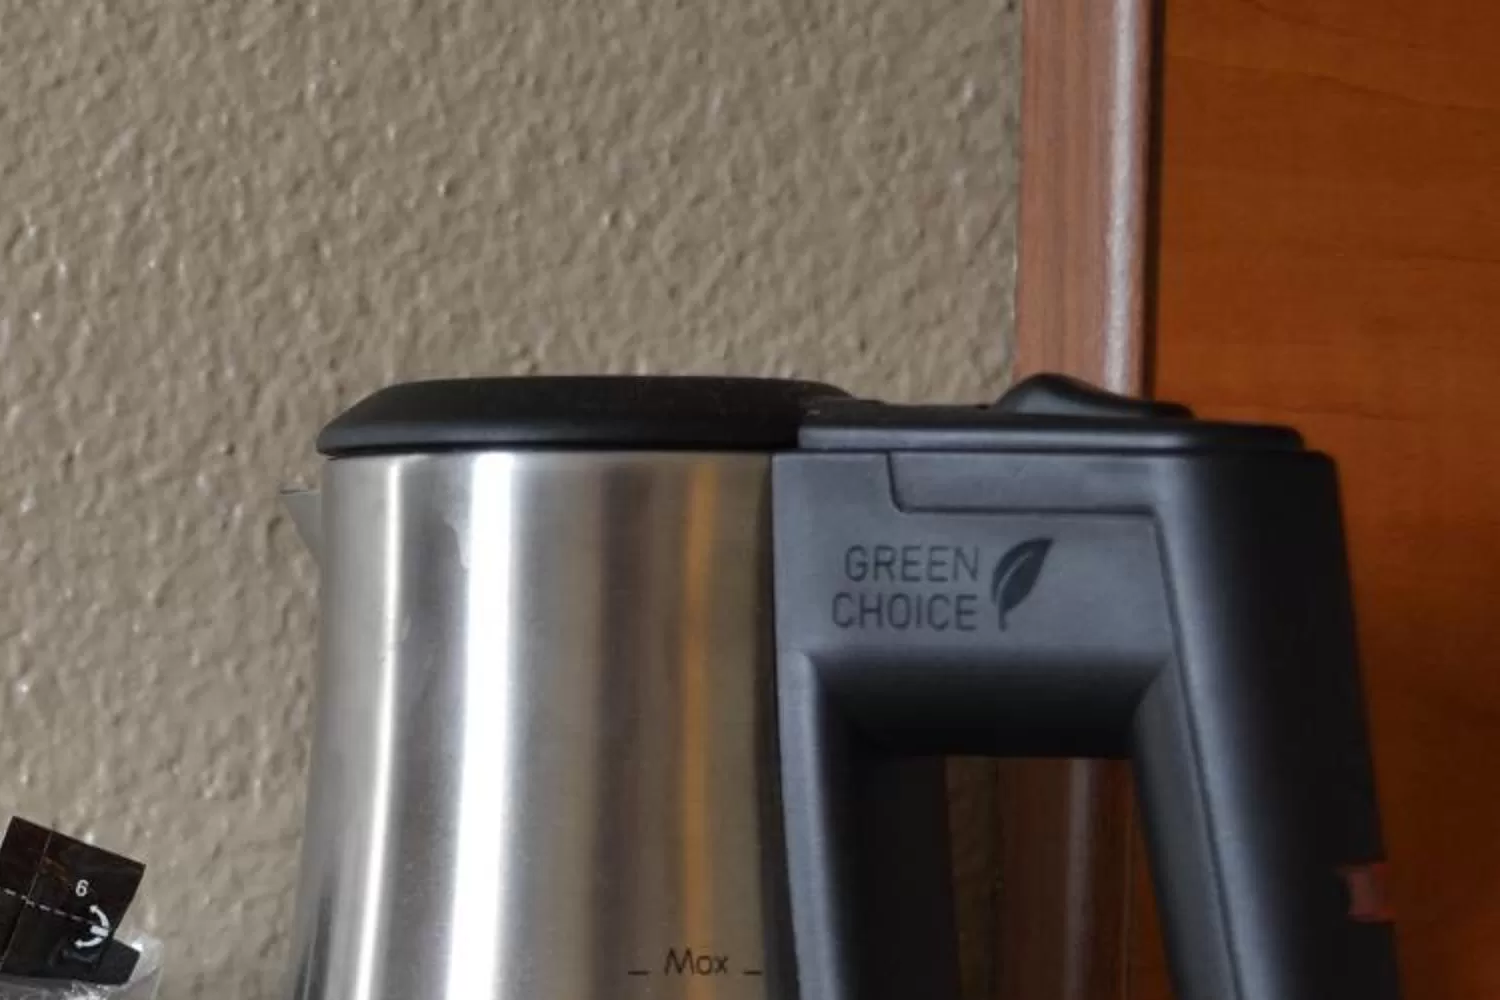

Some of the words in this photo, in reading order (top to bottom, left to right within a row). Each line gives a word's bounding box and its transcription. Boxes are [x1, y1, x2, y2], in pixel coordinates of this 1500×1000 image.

[844, 544, 980, 582] GREEN
[832, 592, 979, 631] CHOICE
[75, 879, 89, 897] 6
[663, 948, 729, 976] Max
